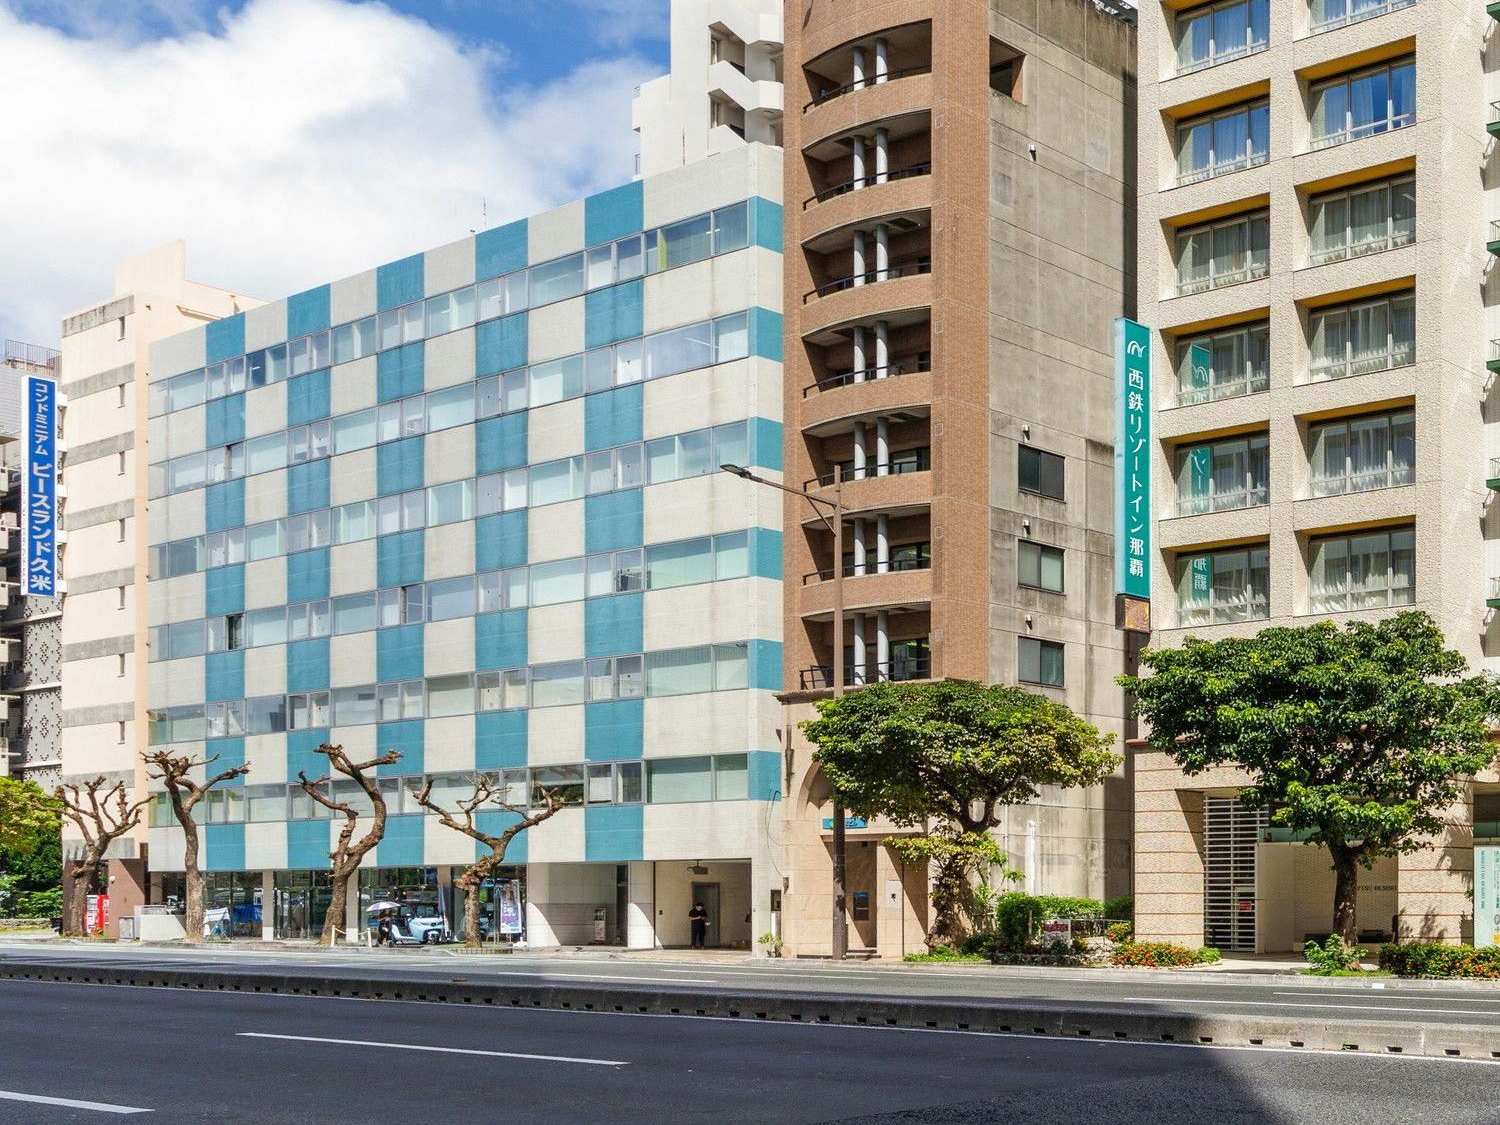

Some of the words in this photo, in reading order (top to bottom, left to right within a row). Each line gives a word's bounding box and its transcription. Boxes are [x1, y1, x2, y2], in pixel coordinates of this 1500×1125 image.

[35, 383, 49, 456] コンドミニアム
[1128, 368, 1146, 578] 西鉄リゾートイン那覇
[31, 462, 52, 591] ピースランド久米
